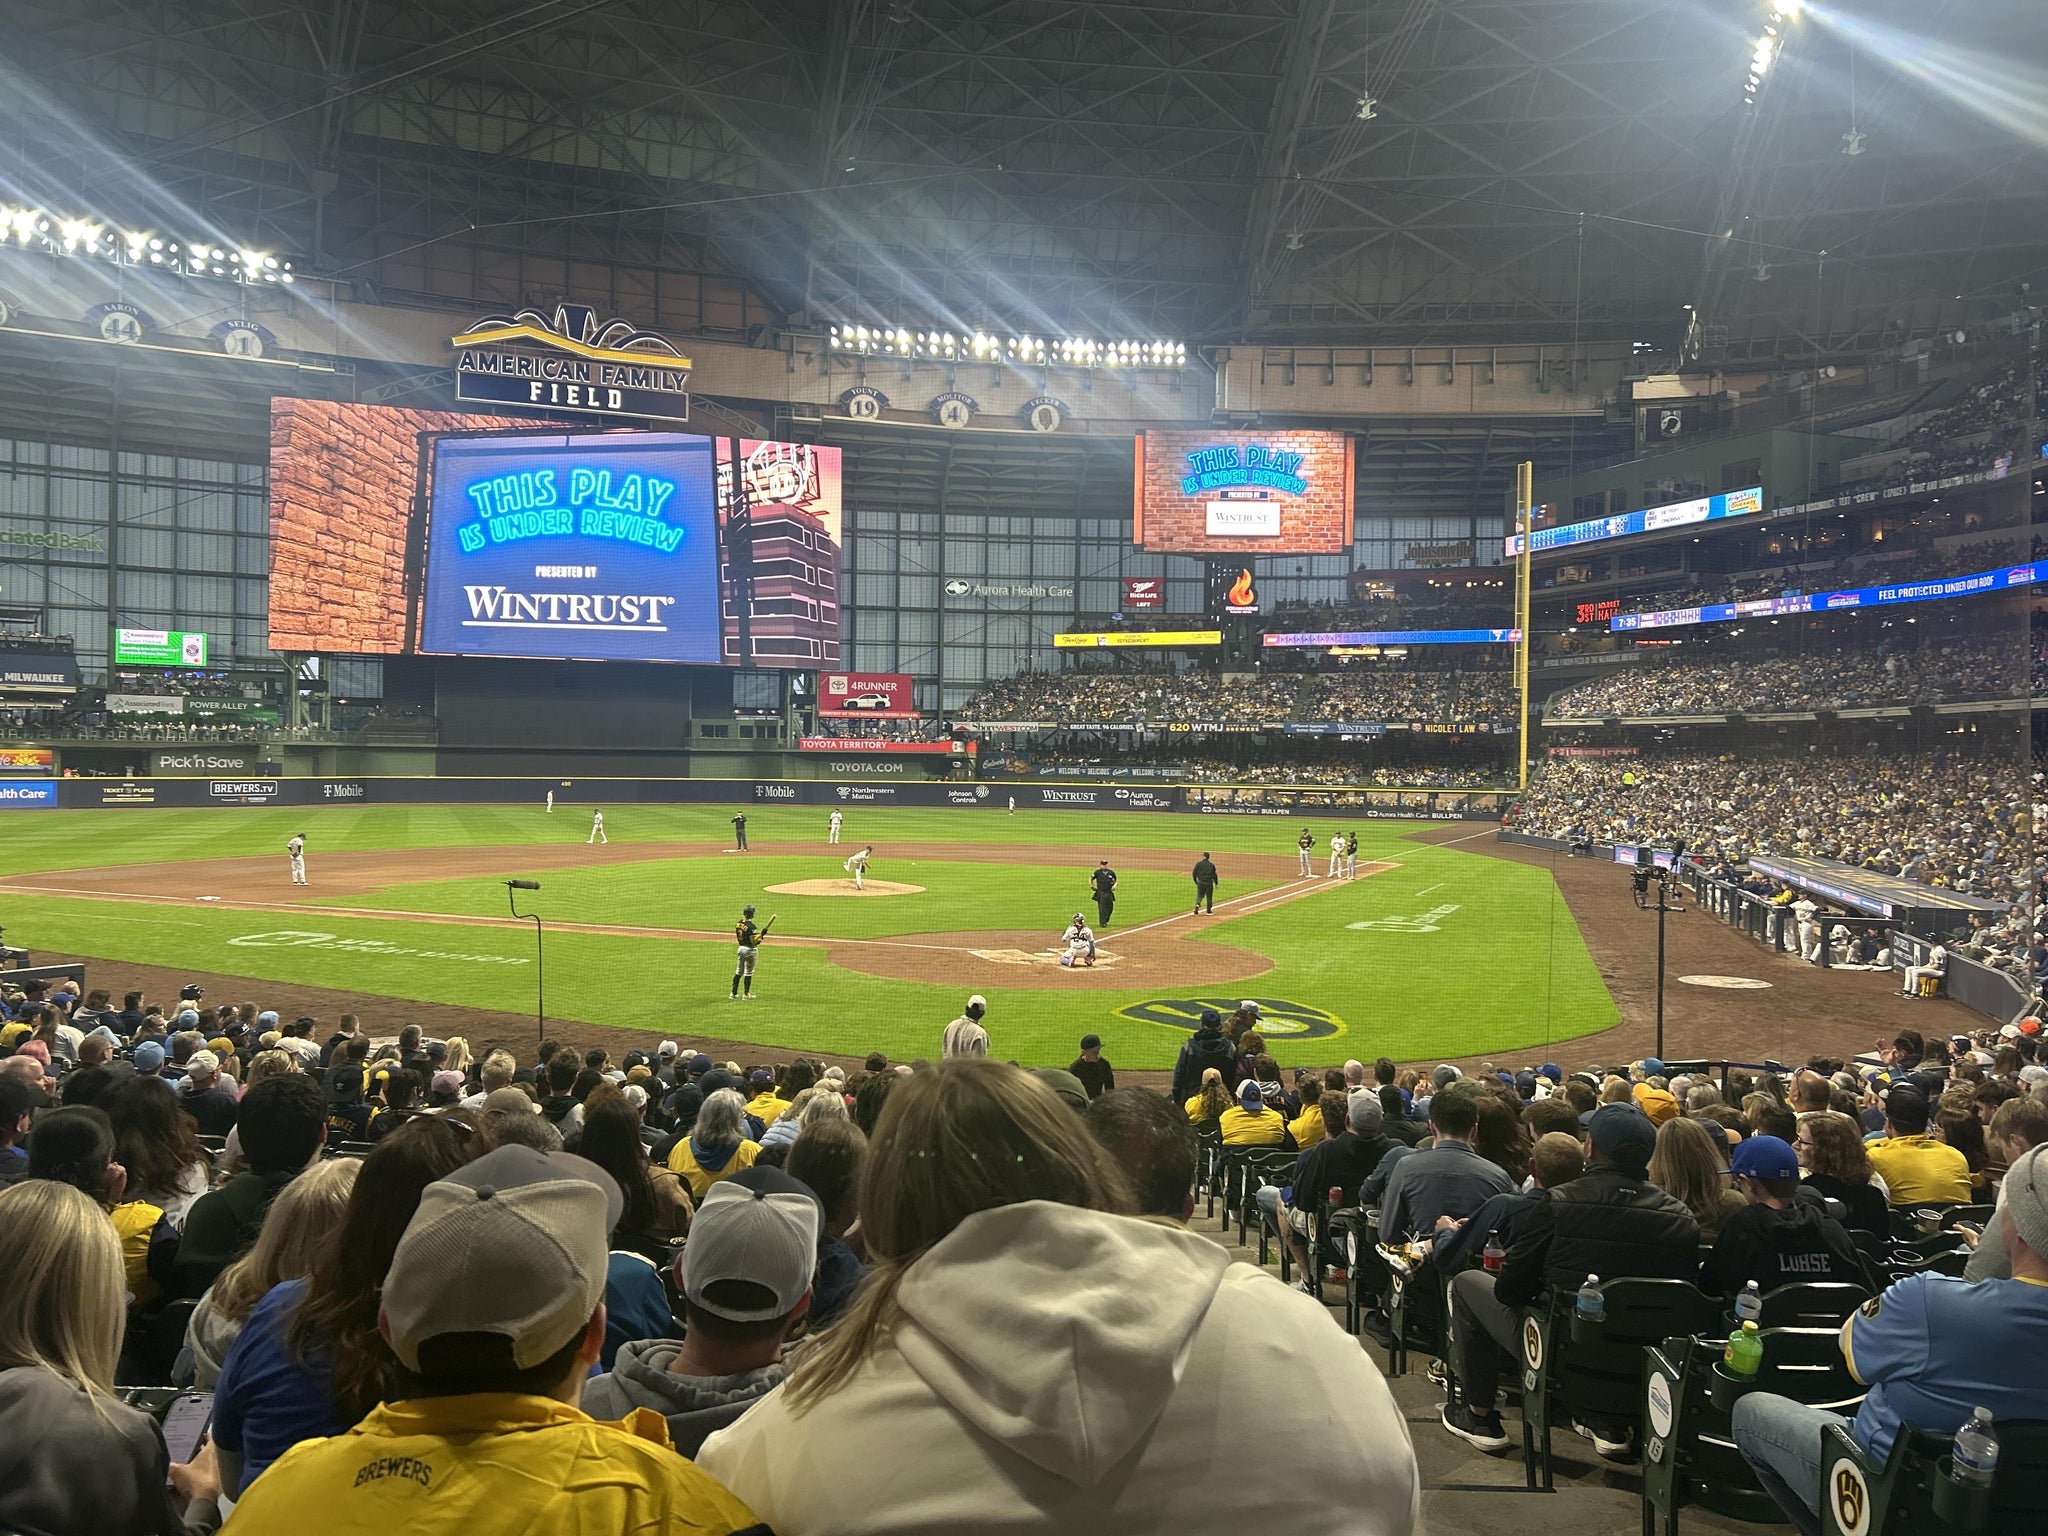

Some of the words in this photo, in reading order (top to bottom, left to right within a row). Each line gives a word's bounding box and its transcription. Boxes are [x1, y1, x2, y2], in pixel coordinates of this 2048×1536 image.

[103, 302, 140, 316] AARON
[105, 318, 137, 340] 44
[227, 320, 260, 332] SELIG
[239, 338, 250, 355] 1
[458, 351, 590, 382] AMERICAN
[601, 364, 687, 392] FAMILY
[530, 381, 622, 409] FIELD
[850, 387, 878, 397] YOUNT
[937, 393, 972, 405] MOLITOR
[853, 400, 875, 417] 19
[948, 406, 958, 421] 4
[1188, 446, 1239, 474] THIS
[1247, 446, 1303, 474] PLAY
[1183, 479, 1199, 493] IS
[1201, 470, 1248, 487] UNDER
[1252, 470, 1306, 494] REVIEW
[469, 470, 557, 518] THIS
[571, 469, 673, 516] PLAY
[459, 524, 485, 552] IS
[489, 509, 573, 542] UNDER
[581, 509, 684, 552] REVIEW
[1404, 541, 1474, 559] Johnsonville
[535, 566, 583, 578] PRESENTED
[584, 566, 597, 578] BY
[974, 585, 1009, 596] Aurora
[1012, 584, 1046, 597] Health
[1049, 586, 1073, 597] Care
[1878, 589, 1896, 600] FEEL
[1898, 584, 1943, 598] PROTECTED
[1945, 581, 1966, 593] UNDER
[1618, 617, 1636, 628] 7:35
[5, 672, 65, 683] MILWAUKEE
[851, 682, 897, 691] 4RUNNER
[189, 701, 220, 709] POWER
[221, 702, 248, 710] ALLEY
[1169, 723, 1189, 732] 620
[1191, 723, 1223, 732] WTMJ
[1337, 724, 1381, 732] WINTRUST
[1425, 724, 1456, 733] NICOLET
[1459, 724, 1476, 733] LAW
[802, 740, 837, 749] TOYOTA
[839, 741, 887, 749] TERRITORY
[160, 755, 192, 768] Pick
[207, 756, 243, 768] Save
[830, 763, 902, 773] TOYOTA.COM
[19, 788, 46, 799] Care
[214, 783, 273, 793] BREWERS.TV
[334, 785, 363, 797] Mobile
[765, 786, 795, 798] Mobile
[1042, 790, 1096, 801] WINTRUST
[1130, 798, 1152, 806] Health
[1153, 799, 1171, 807] Care
[1650, 1441, 1661, 1458] 15
[353, 1457, 432, 1488] BREWERS
